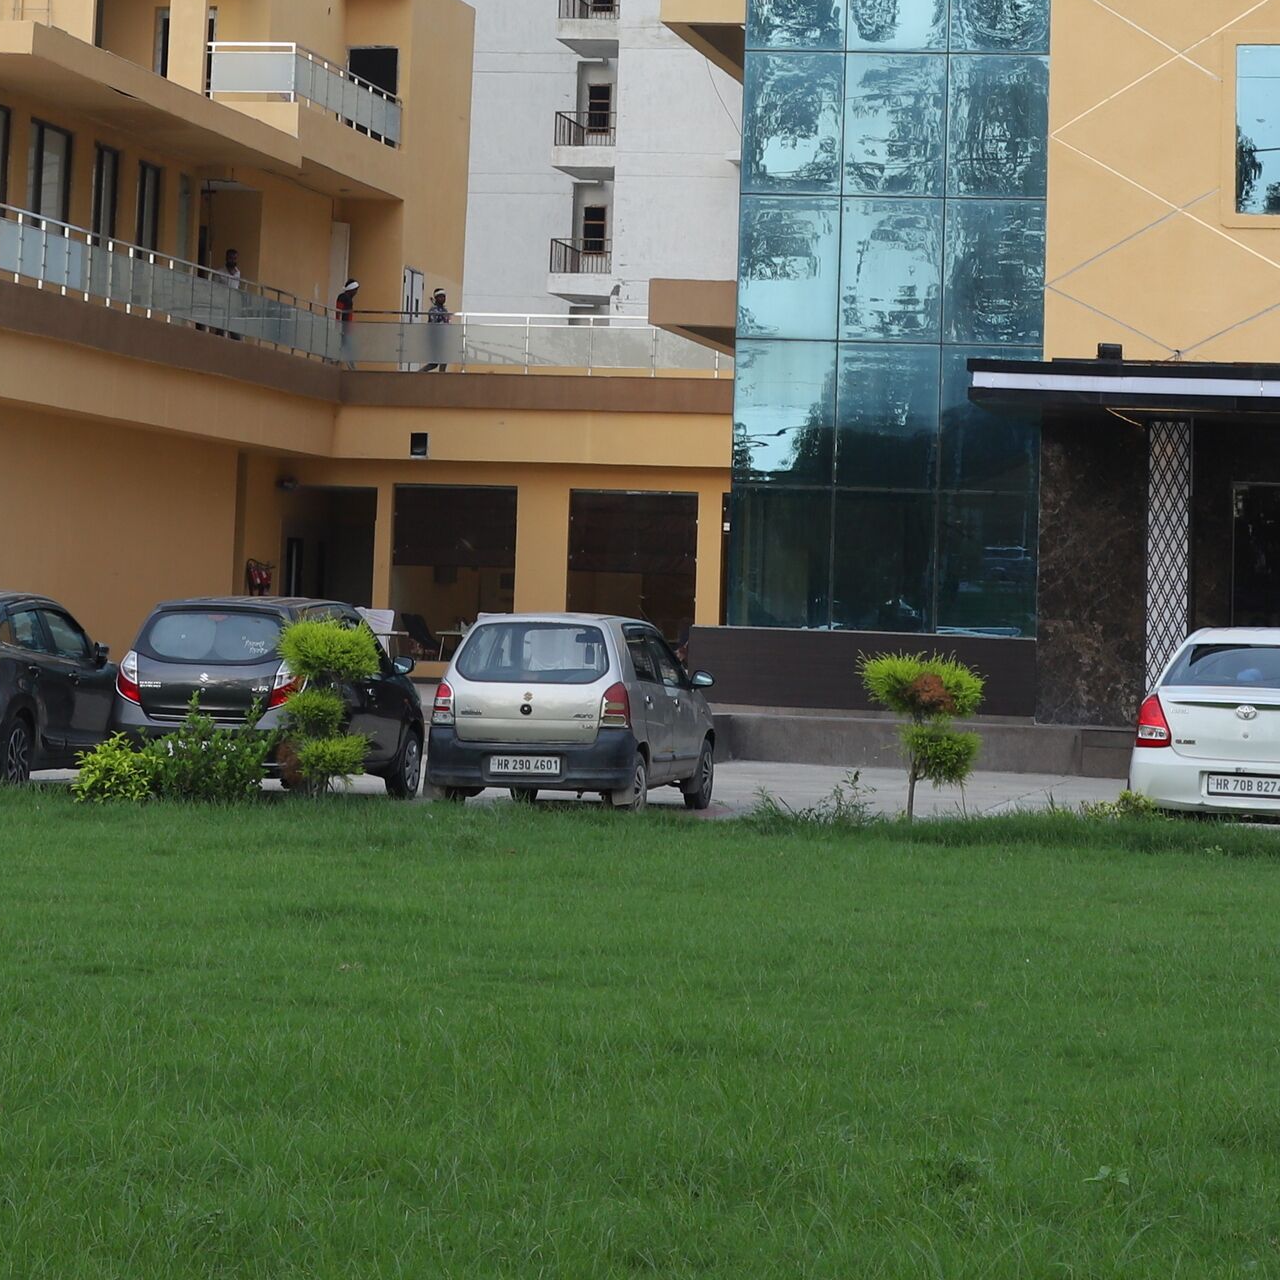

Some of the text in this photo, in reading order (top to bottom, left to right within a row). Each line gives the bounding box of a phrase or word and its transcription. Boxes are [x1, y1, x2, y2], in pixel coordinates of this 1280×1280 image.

[497, 759, 510, 770] HR
[533, 760, 558, 770] 4601
[1216, 778, 1229, 790] HR
[1233, 779, 1253, 791] 70B
